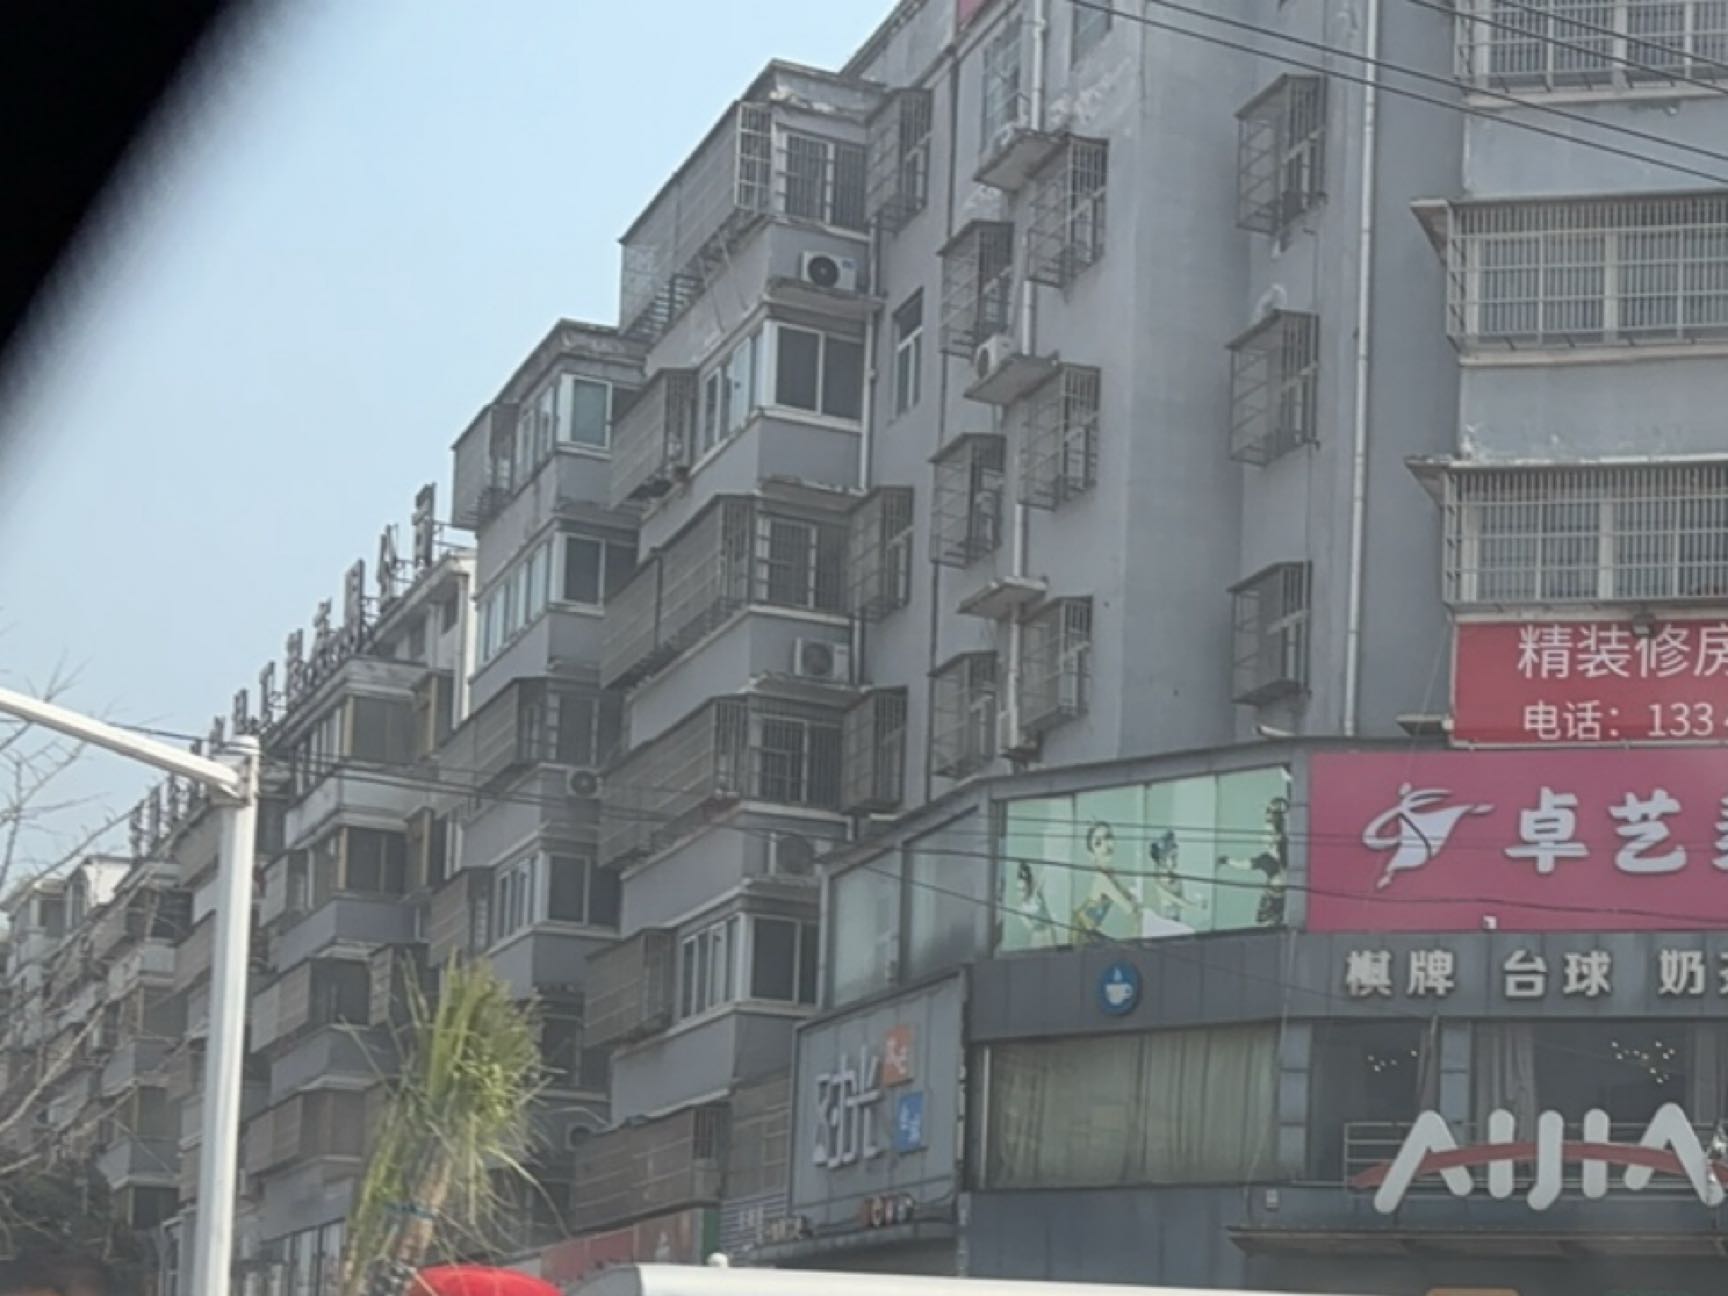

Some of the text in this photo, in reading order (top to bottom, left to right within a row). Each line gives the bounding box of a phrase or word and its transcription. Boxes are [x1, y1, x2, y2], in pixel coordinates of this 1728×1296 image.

[1648, 702, 1714, 736] 133
[1346, 950, 1455, 997] 棋牌
[1504, 950, 1612, 997] 台球
